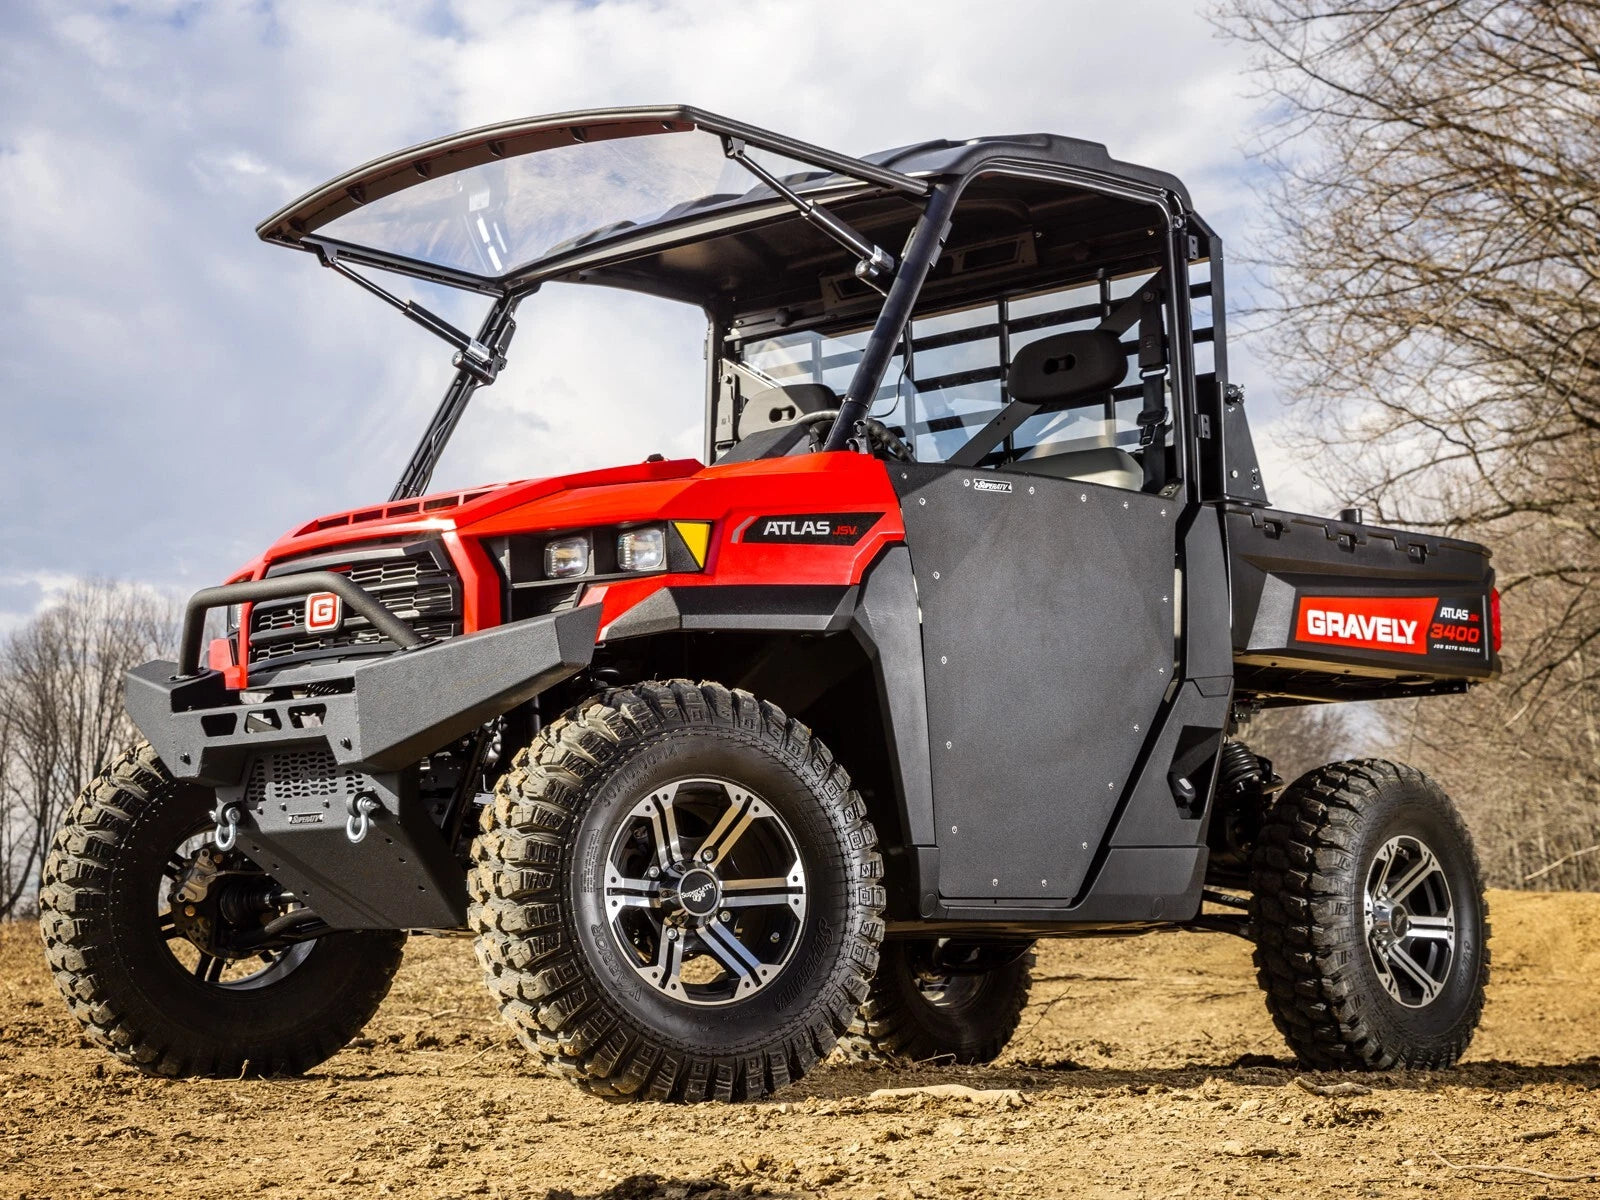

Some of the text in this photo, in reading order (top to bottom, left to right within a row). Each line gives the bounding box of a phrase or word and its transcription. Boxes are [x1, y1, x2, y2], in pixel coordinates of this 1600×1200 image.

[763, 521, 830, 536] ATLAS
[313, 598, 333, 623] G
[1440, 606, 1469, 621] ATLAS
[1306, 609, 1418, 645] GRAVELY
[1430, 623, 1480, 643] 3400
[1459, 646, 1481, 654] VEHICLE
